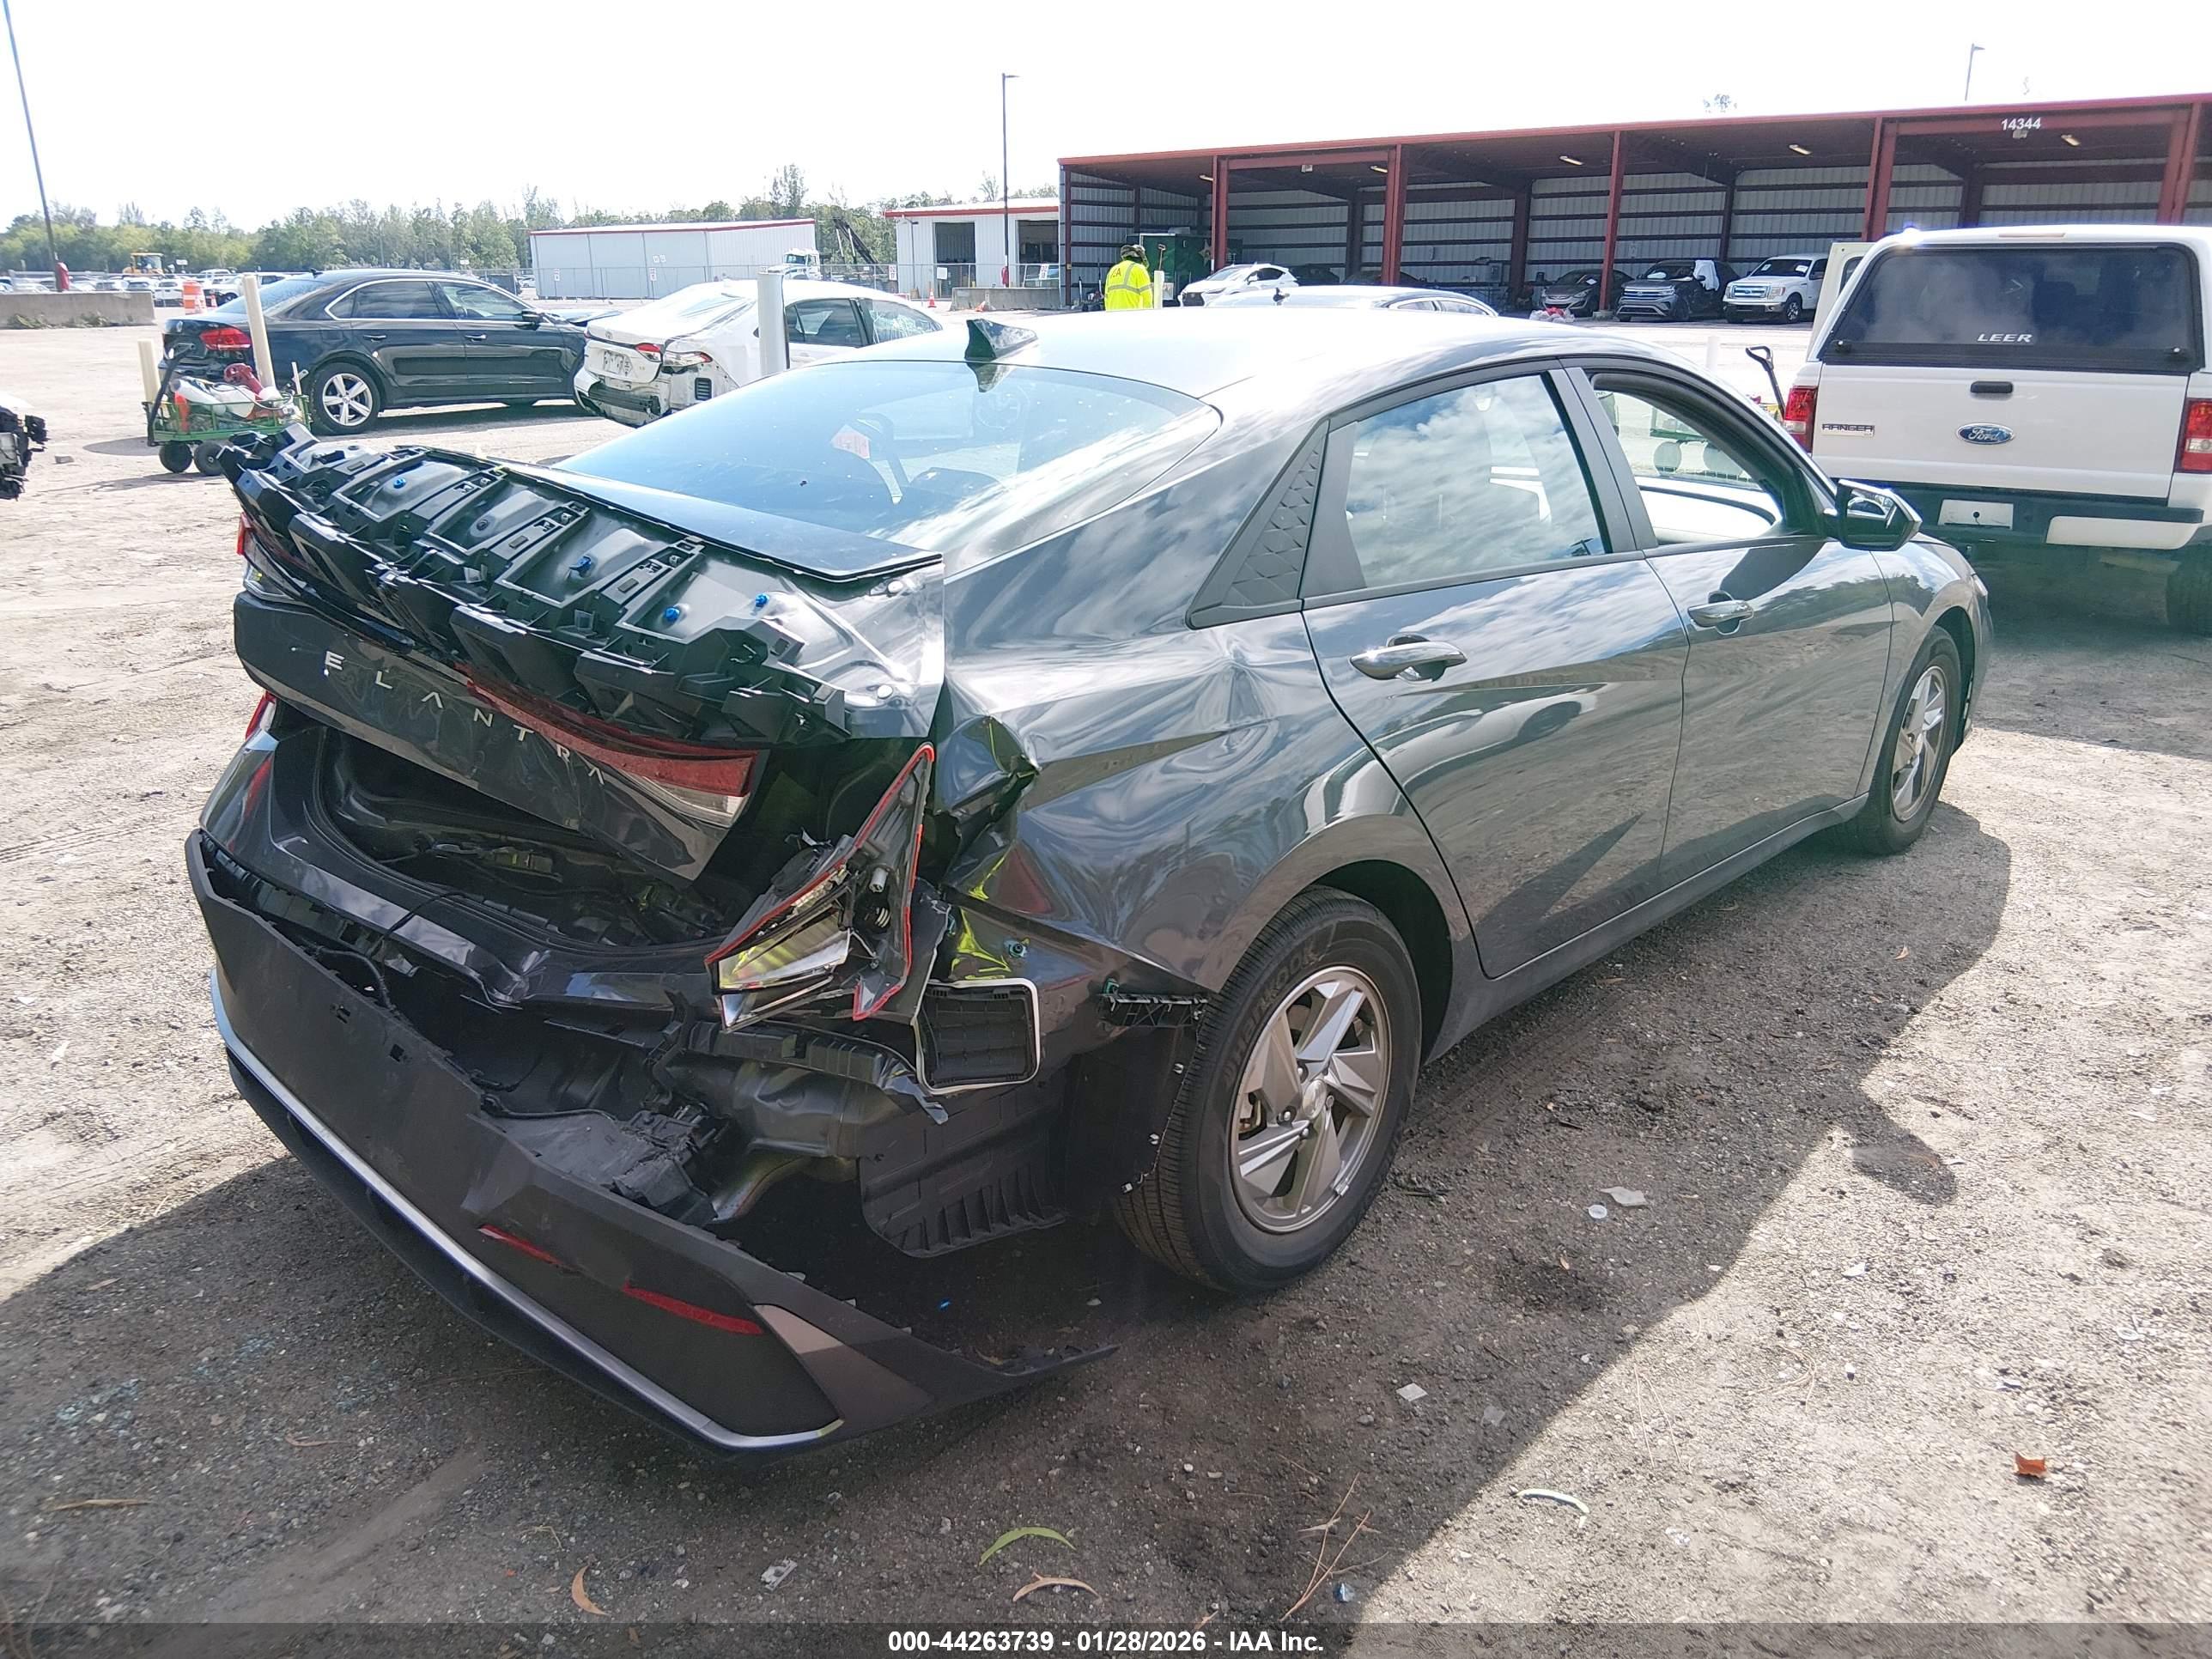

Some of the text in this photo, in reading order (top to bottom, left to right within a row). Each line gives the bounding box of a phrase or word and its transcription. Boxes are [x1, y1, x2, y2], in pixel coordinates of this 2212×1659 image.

[2001, 117, 2041, 131] 14344
[1977, 333, 2033, 343] LEER
[1821, 423, 1875, 432] RANGER
[1968, 427, 2002, 441] Ford
[325, 651, 605, 785] ELANTRA
